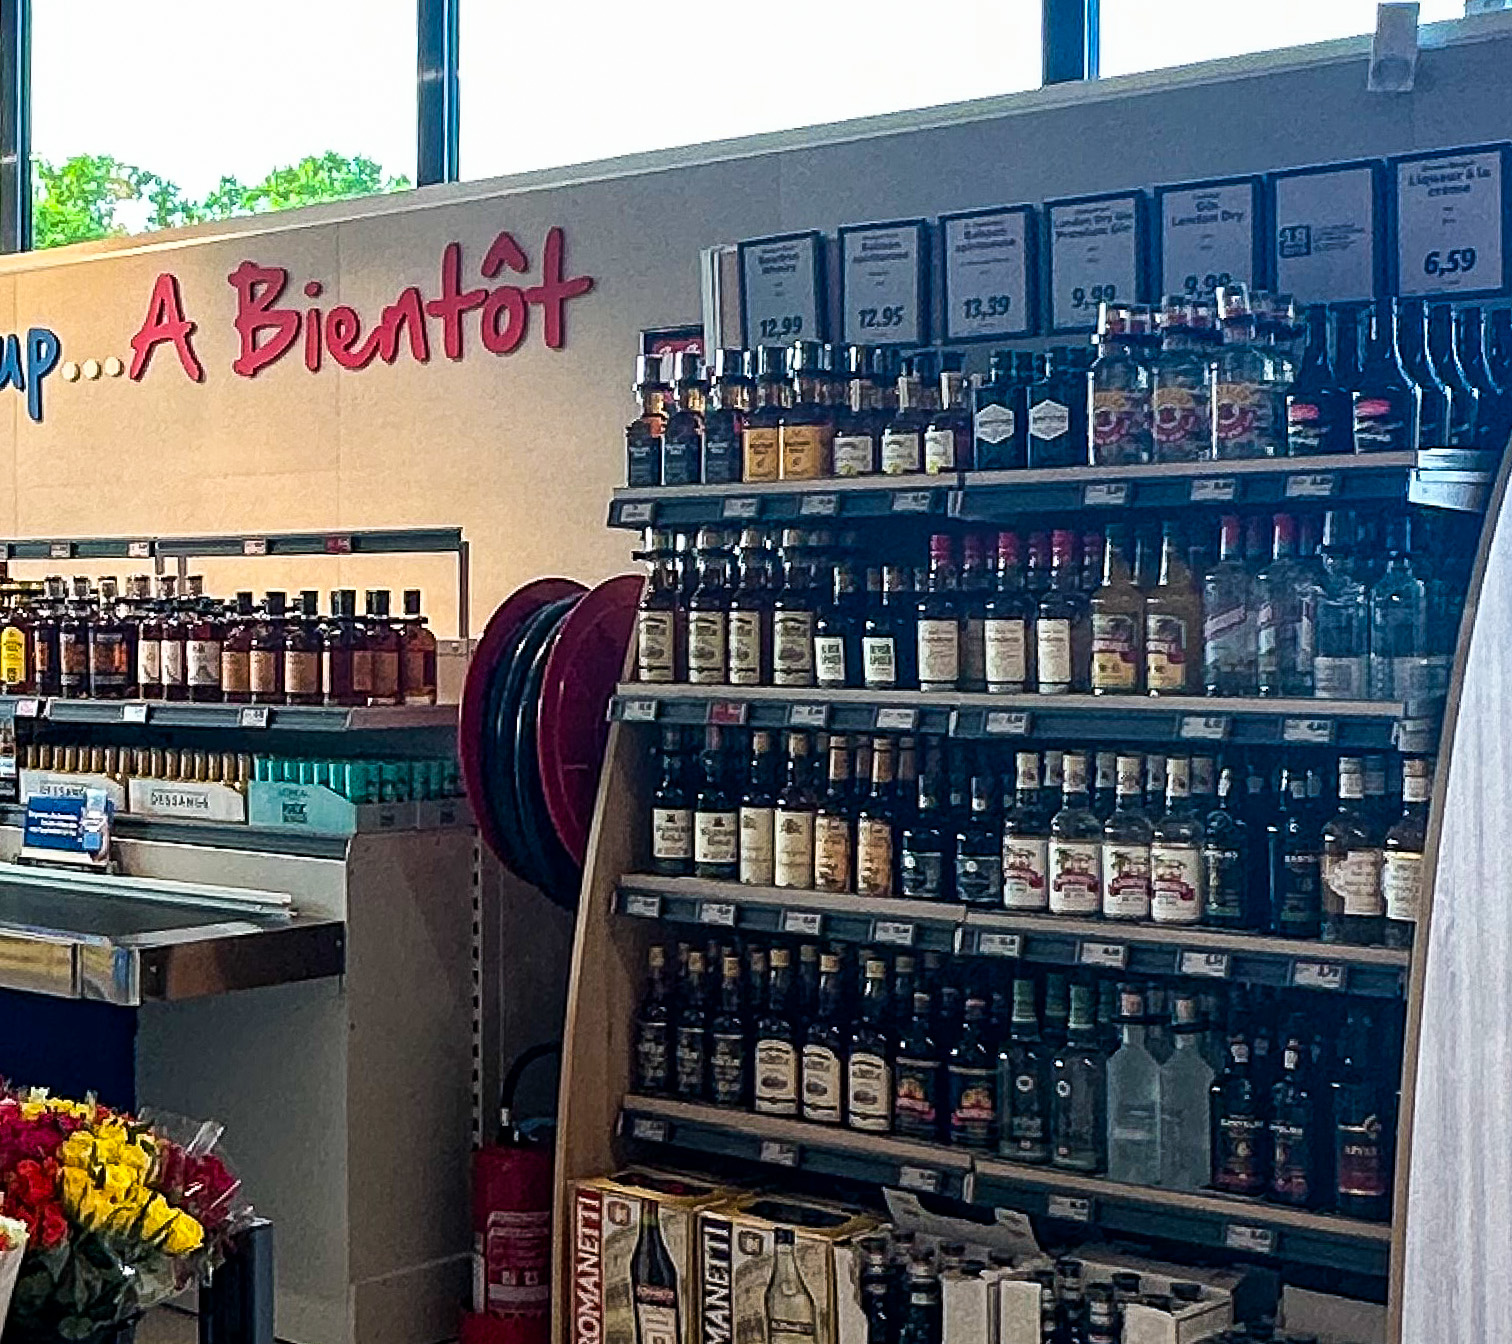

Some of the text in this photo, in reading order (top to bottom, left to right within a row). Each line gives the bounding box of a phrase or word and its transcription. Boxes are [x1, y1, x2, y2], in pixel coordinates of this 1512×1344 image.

[1424, 247, 1477, 277] 6,59
[127, 273, 205, 382] A
[228, 227, 595, 377] Bientôt
[760, 315, 803, 339] 12,99
